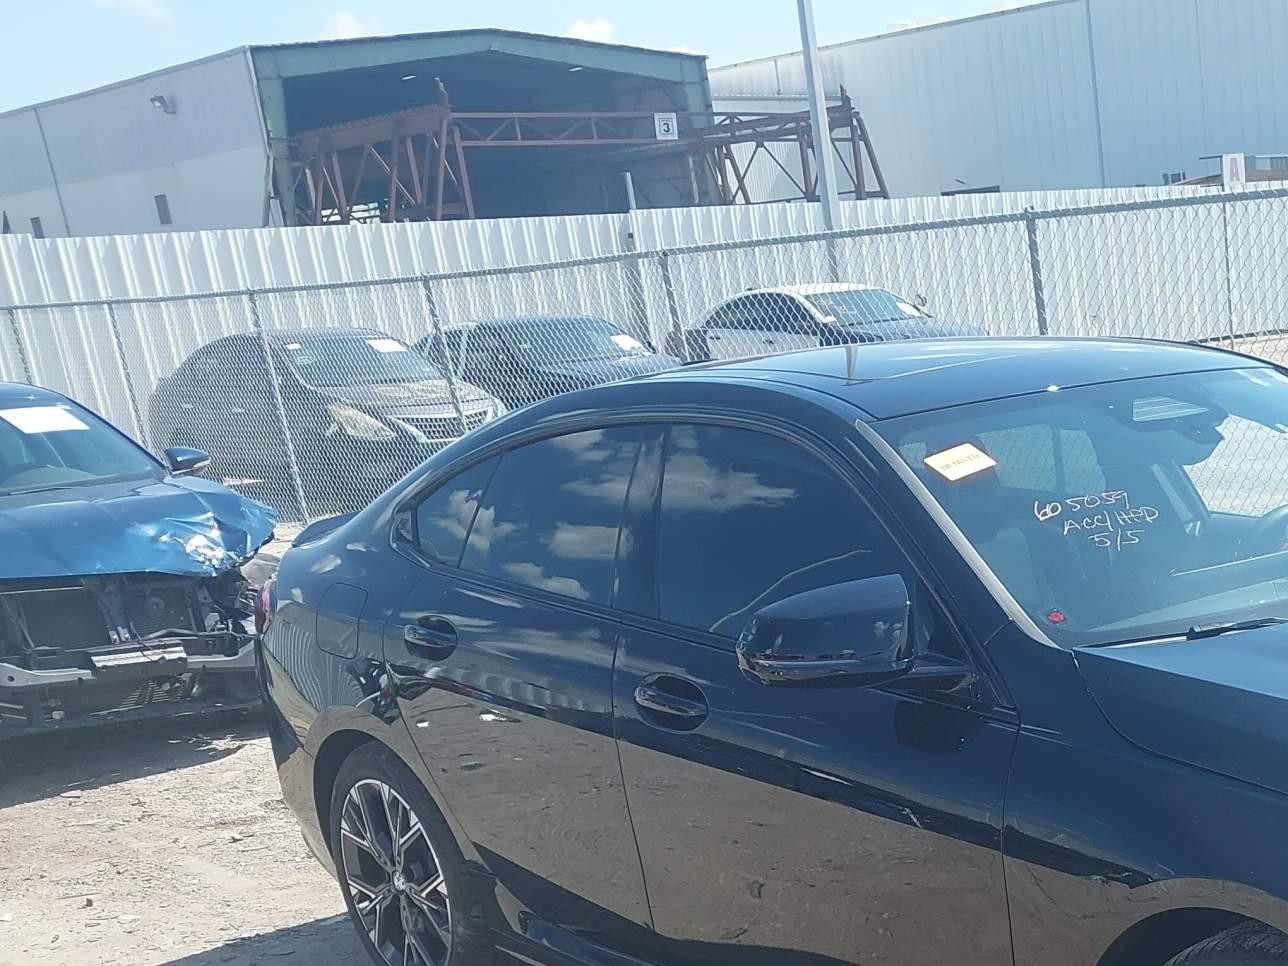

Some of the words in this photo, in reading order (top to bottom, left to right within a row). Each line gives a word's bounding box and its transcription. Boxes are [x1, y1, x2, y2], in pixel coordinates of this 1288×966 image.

[662, 122, 671, 133] 3
[1229, 157, 1241, 182] A
[1087, 528, 1146, 552] 5/5
